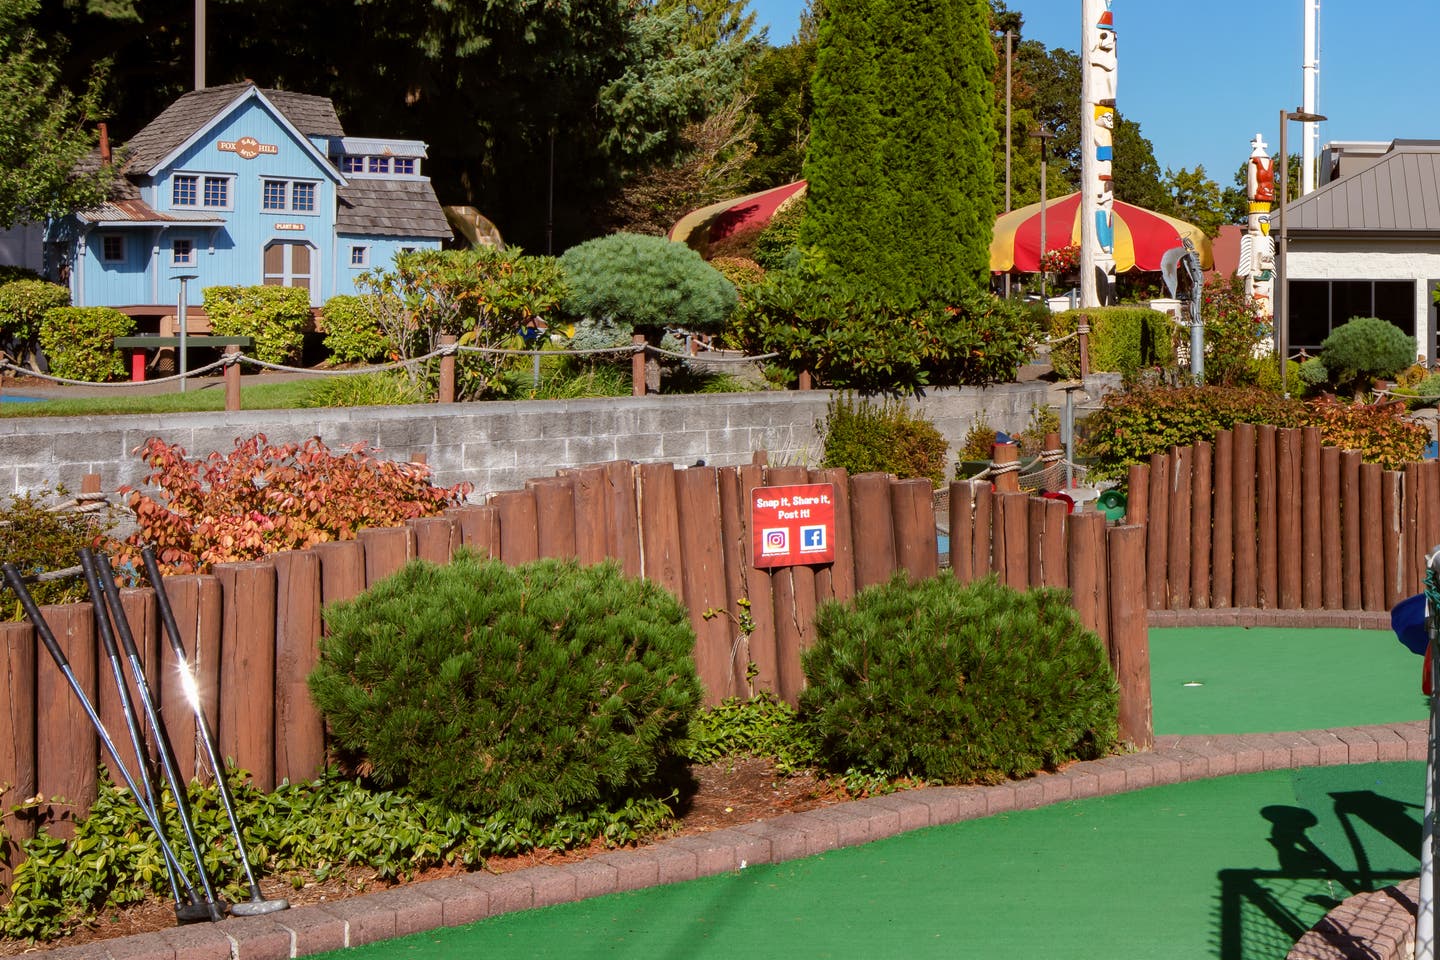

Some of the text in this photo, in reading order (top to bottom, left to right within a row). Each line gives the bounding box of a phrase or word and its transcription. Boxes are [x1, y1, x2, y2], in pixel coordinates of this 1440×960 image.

[220, 142, 277, 153] FOX HILL
[756, 498, 779, 509] Snap
[792, 496, 819, 506] Share
[778, 509, 799, 520] Post
